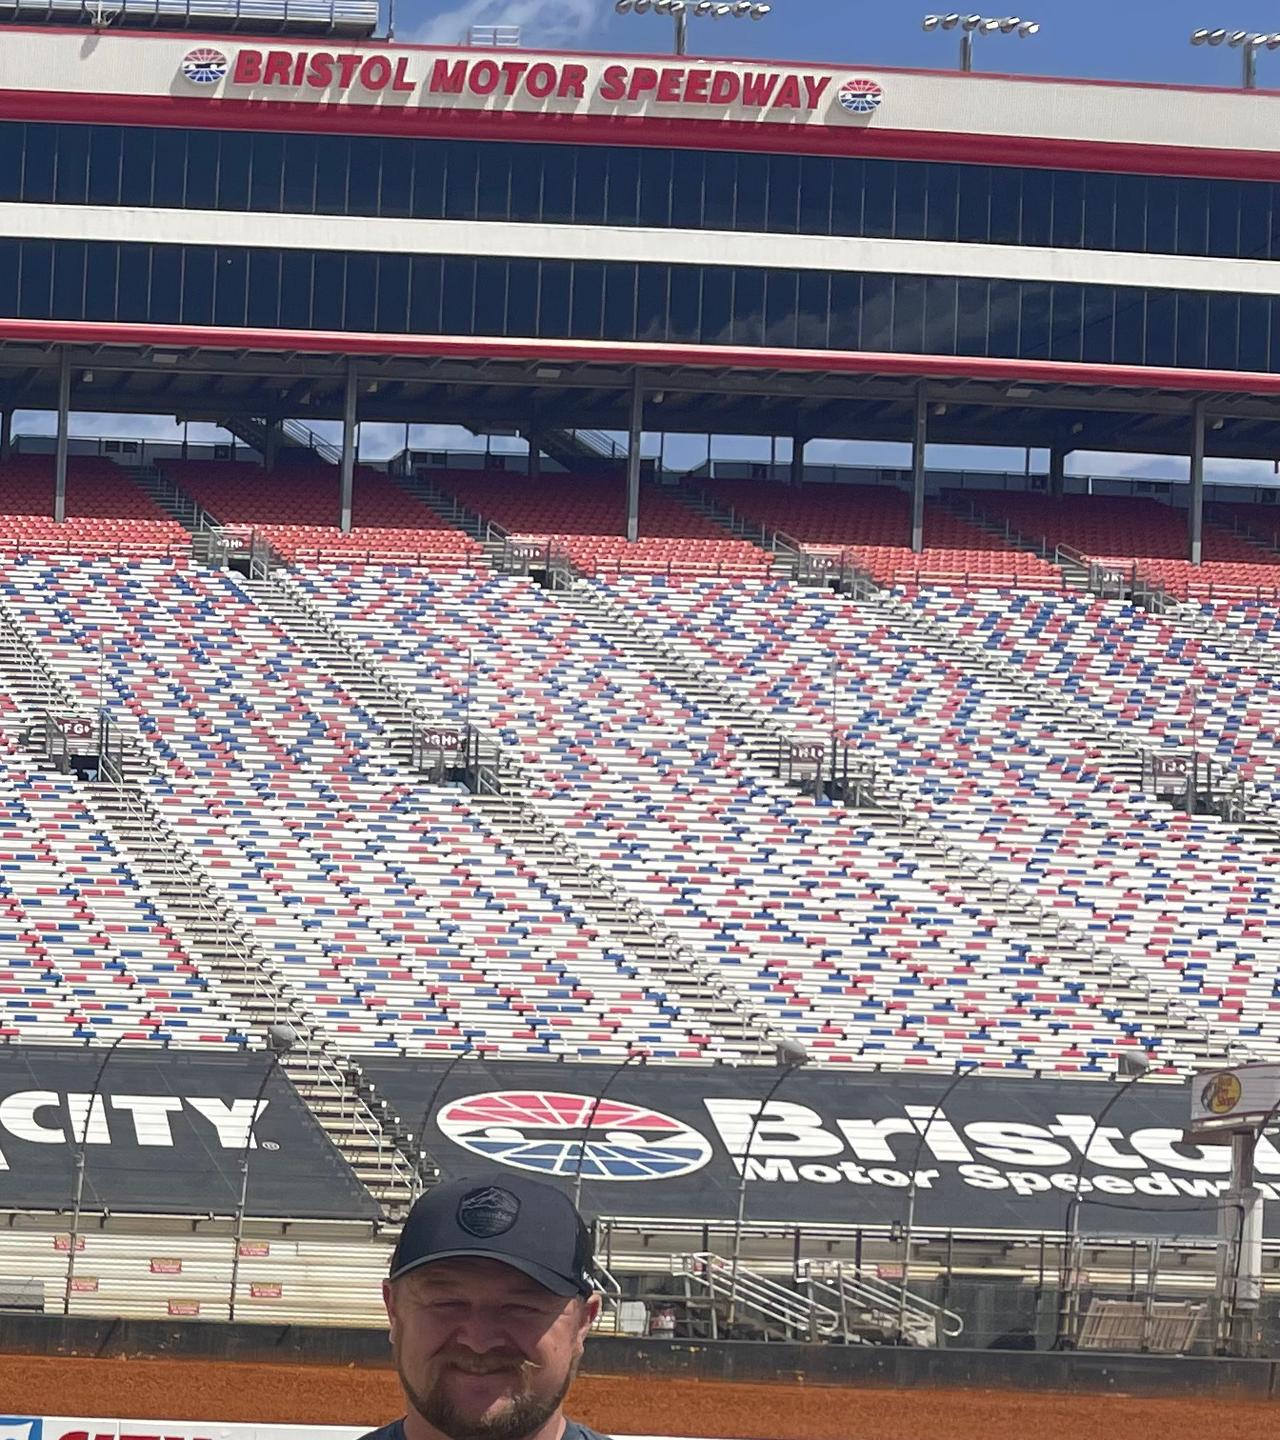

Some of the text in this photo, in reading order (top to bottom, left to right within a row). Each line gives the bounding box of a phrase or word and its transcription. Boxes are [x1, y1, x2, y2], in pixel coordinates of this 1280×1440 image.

[233, 48, 833, 110] BRISTOL MOTOR SPEEDWAY
[733, 1157, 940, 1190] Motor
